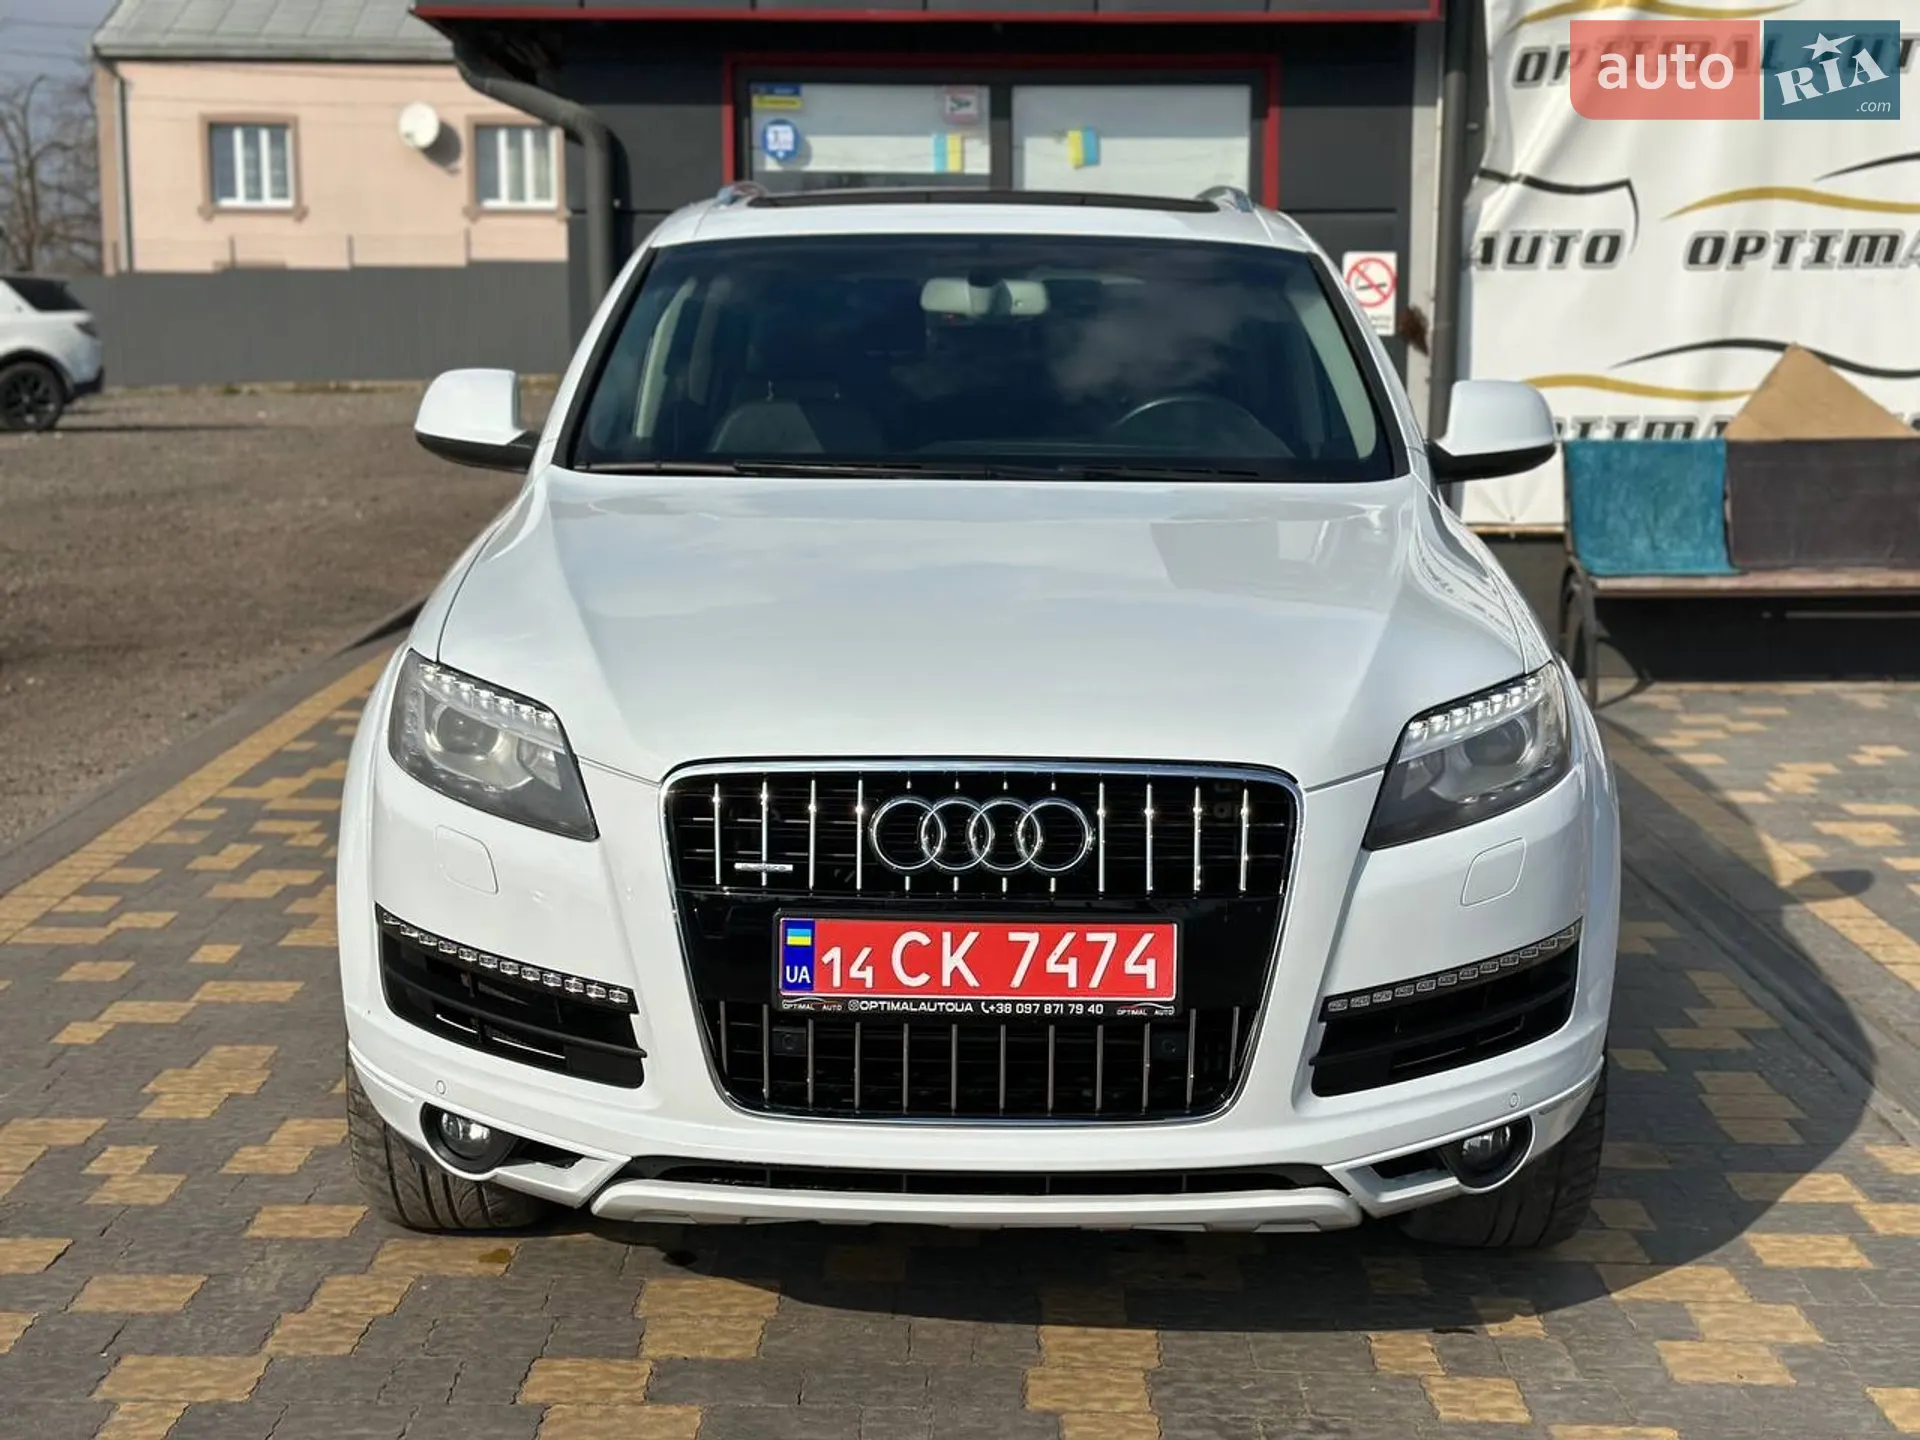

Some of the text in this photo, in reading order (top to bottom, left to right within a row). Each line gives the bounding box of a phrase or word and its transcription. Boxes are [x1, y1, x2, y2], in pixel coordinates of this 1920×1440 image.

[820, 930, 1156, 990] 14 CK 7474
[785, 965, 812, 984] UA
[782, 1002, 816, 1011] OPTIMAL
[1015, 1003, 1040, 1015] 097
[1043, 1003, 1065, 1015] 871
[1068, 1003, 1085, 1015] 79
[1087, 1004, 1105, 1015] 40
[1116, 1008, 1175, 1016] OPTIMAL AUTO
